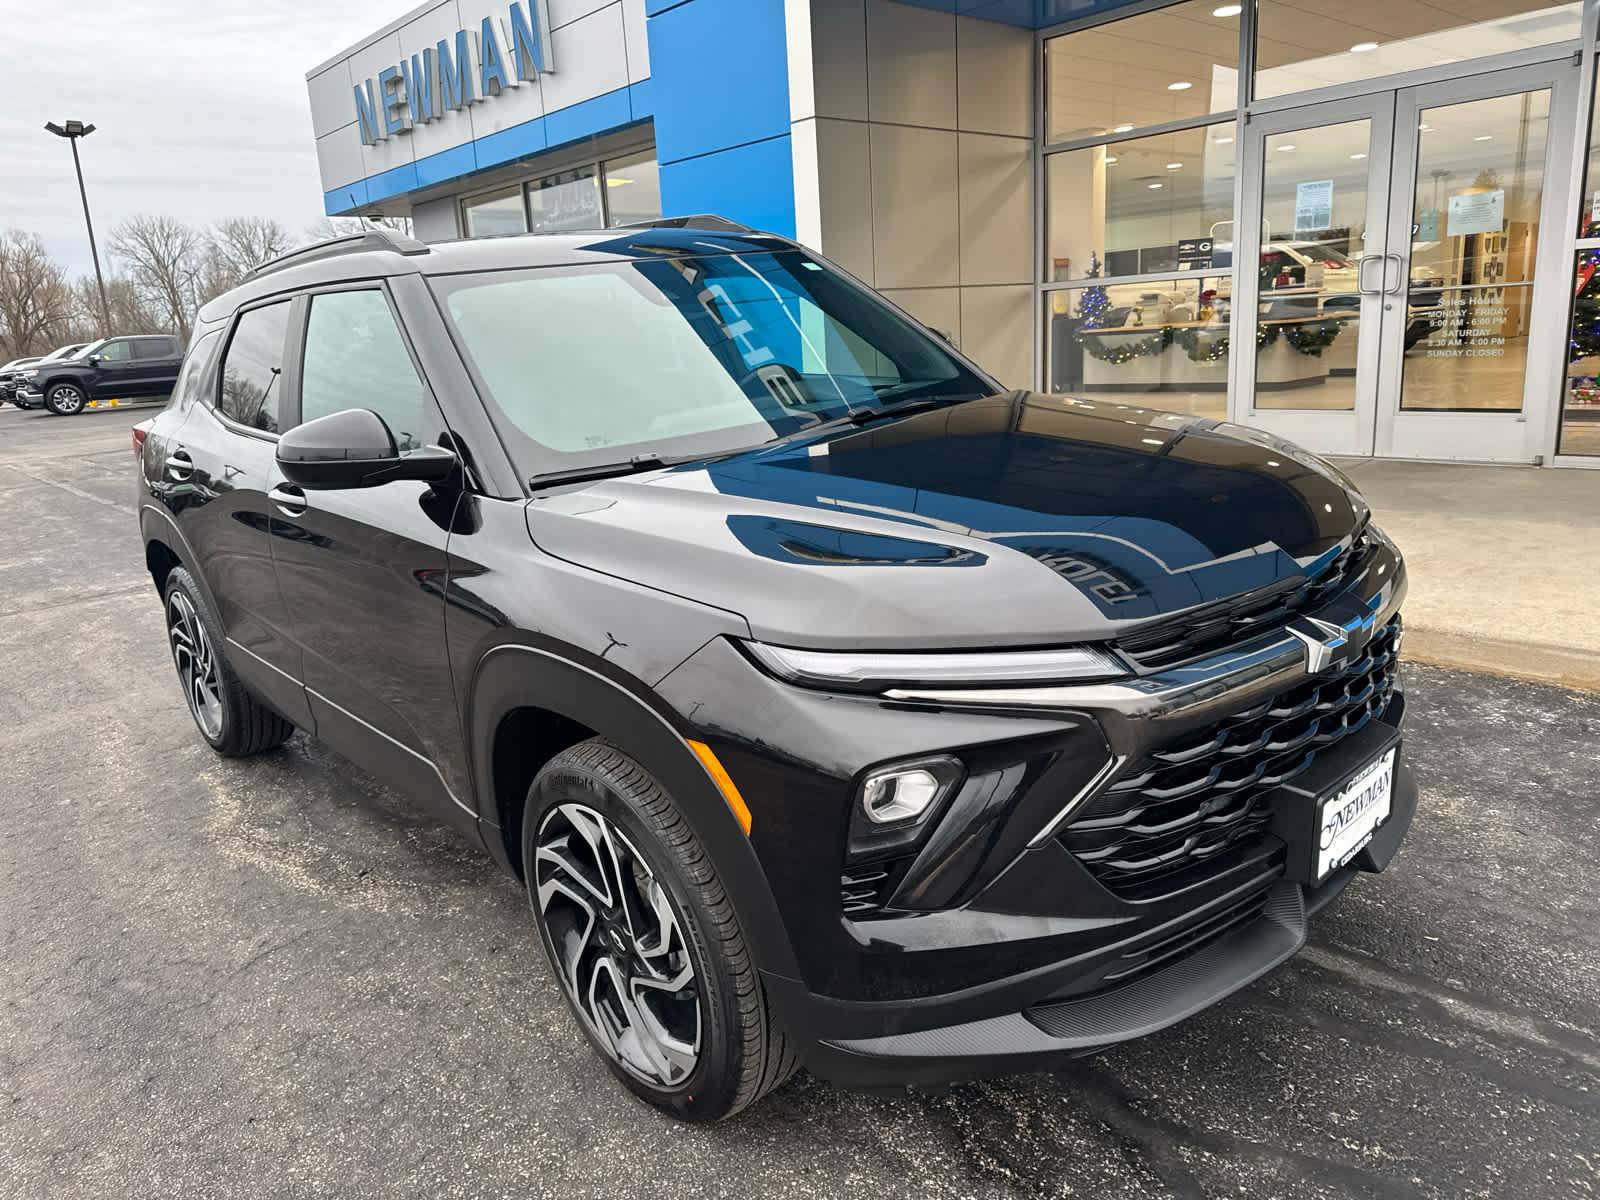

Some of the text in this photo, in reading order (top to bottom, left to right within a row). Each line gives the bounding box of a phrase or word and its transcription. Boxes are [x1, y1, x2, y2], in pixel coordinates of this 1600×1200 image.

[353, 0, 556, 146] NEWMAN
[1428, 309, 1467, 318] MONDAY
[1474, 307, 1510, 316] FRIDAY
[1449, 318, 1464, 326] AM
[1442, 328, 1490, 337] SATURDAY
[1447, 338, 1463, 346] AM
[1491, 337, 1505, 345] PM
[1427, 348, 1505, 358] SUNDAY CLOSED
[1320, 768, 1391, 851] NEWMAN
